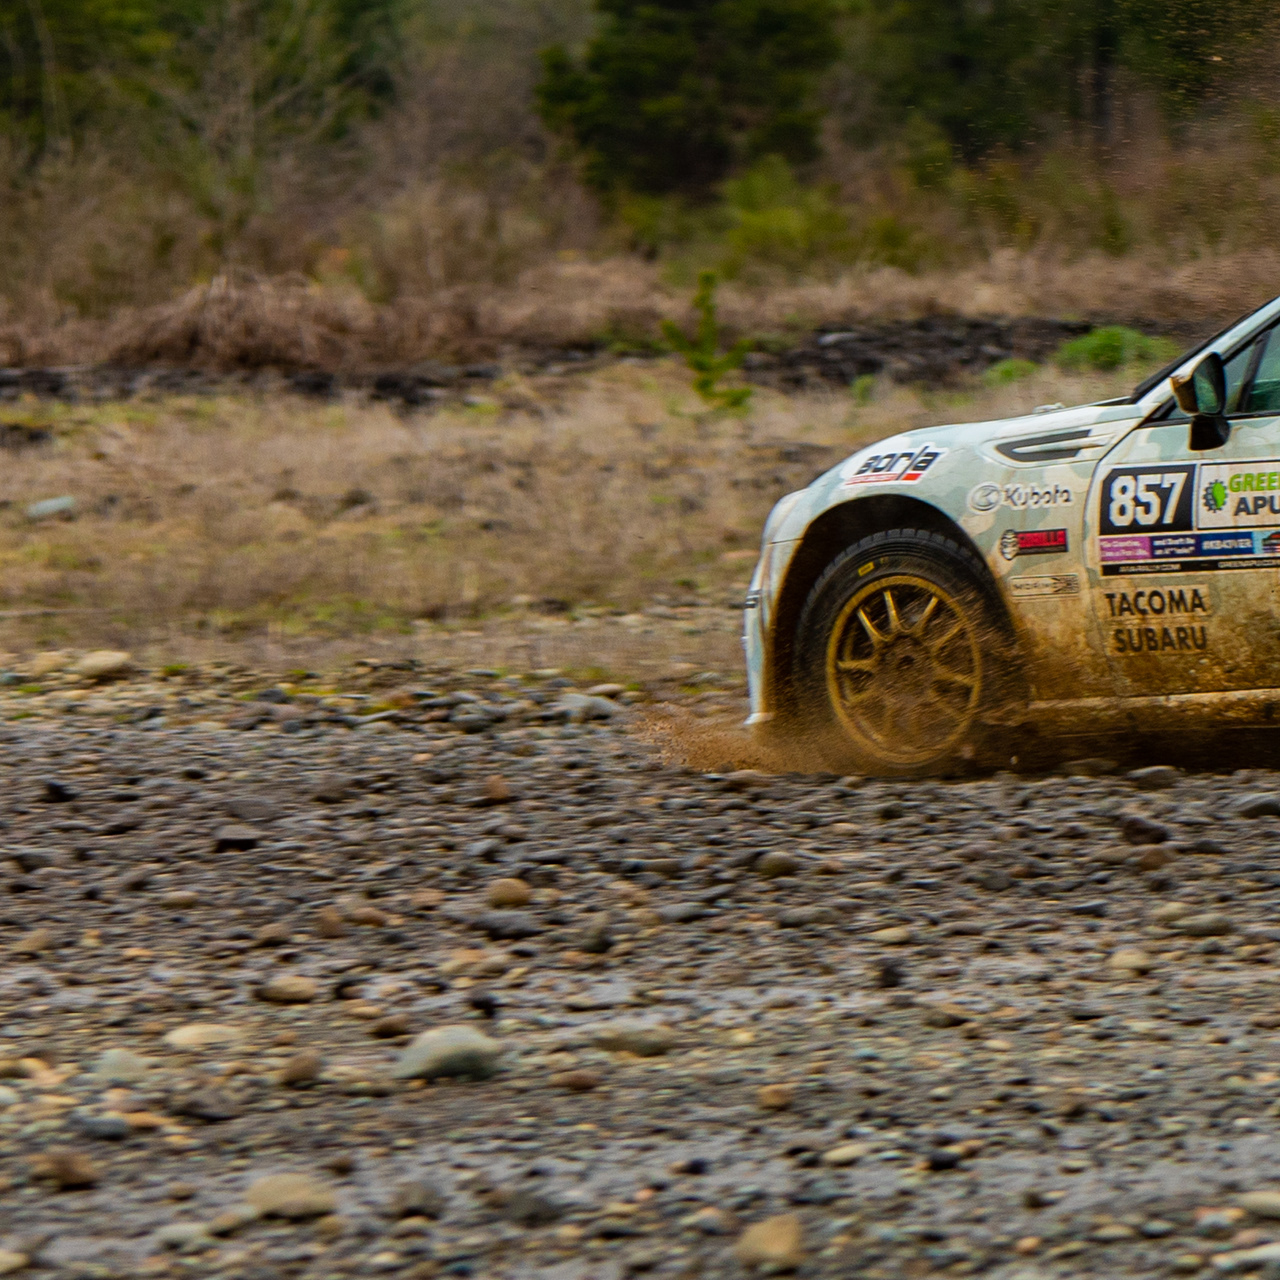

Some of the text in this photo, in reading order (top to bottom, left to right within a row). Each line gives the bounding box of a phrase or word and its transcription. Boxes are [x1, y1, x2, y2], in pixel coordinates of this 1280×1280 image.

[1109, 472, 1189, 527] 857
[1104, 588, 1207, 617] TACOMA
[1114, 625, 1208, 653] SUBARU
